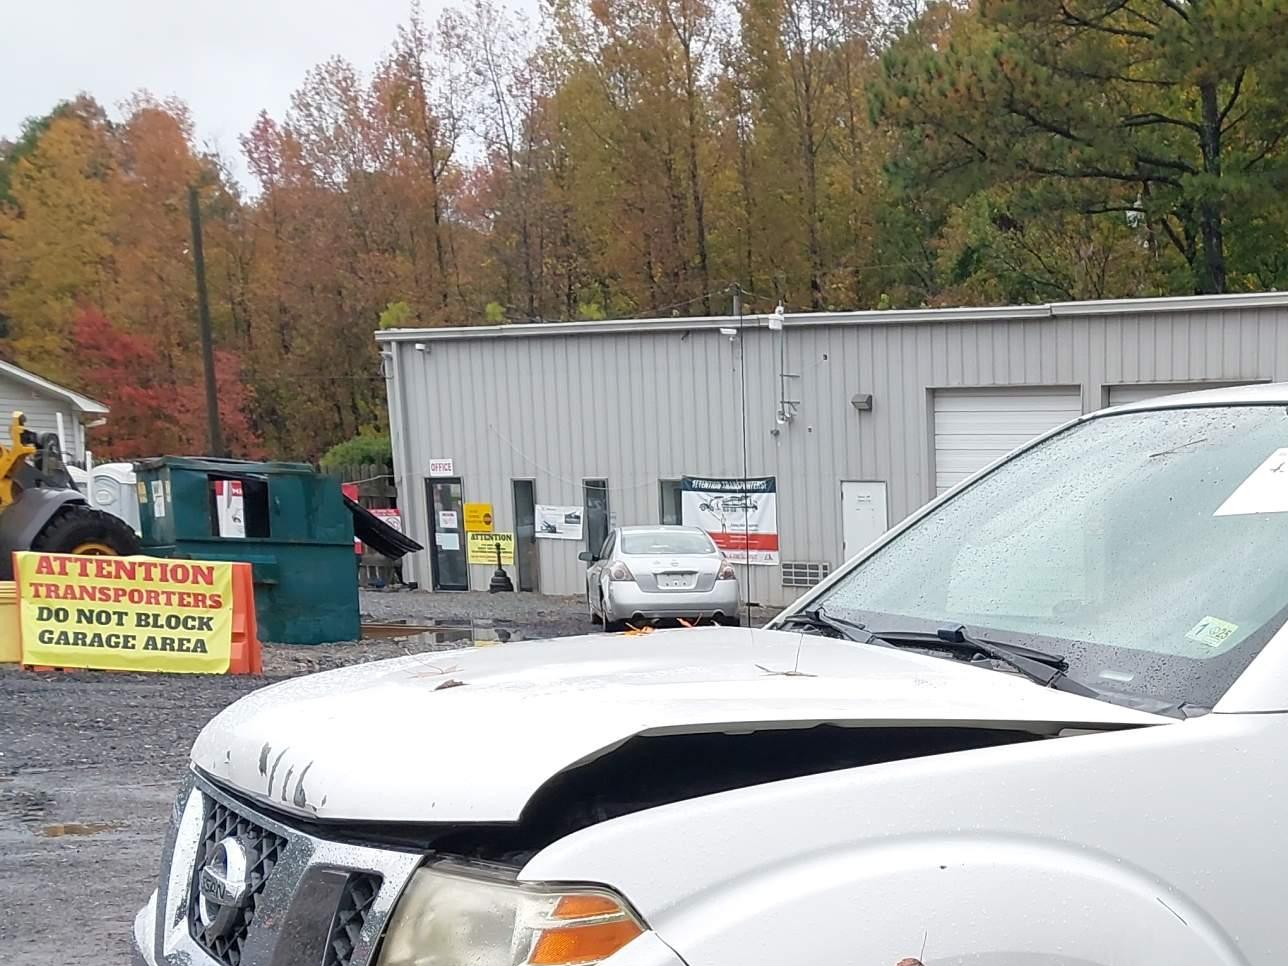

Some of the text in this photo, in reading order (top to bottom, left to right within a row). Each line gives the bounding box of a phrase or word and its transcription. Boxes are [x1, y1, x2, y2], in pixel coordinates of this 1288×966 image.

[431, 463, 452, 472] OFFICE
[35, 555, 215, 586] ATTENTION
[29, 582, 223, 609] TRANSPORTERS
[36, 606, 214, 631] DO NOT BLOCK
[38, 630, 208, 653] GARAGE AREA
